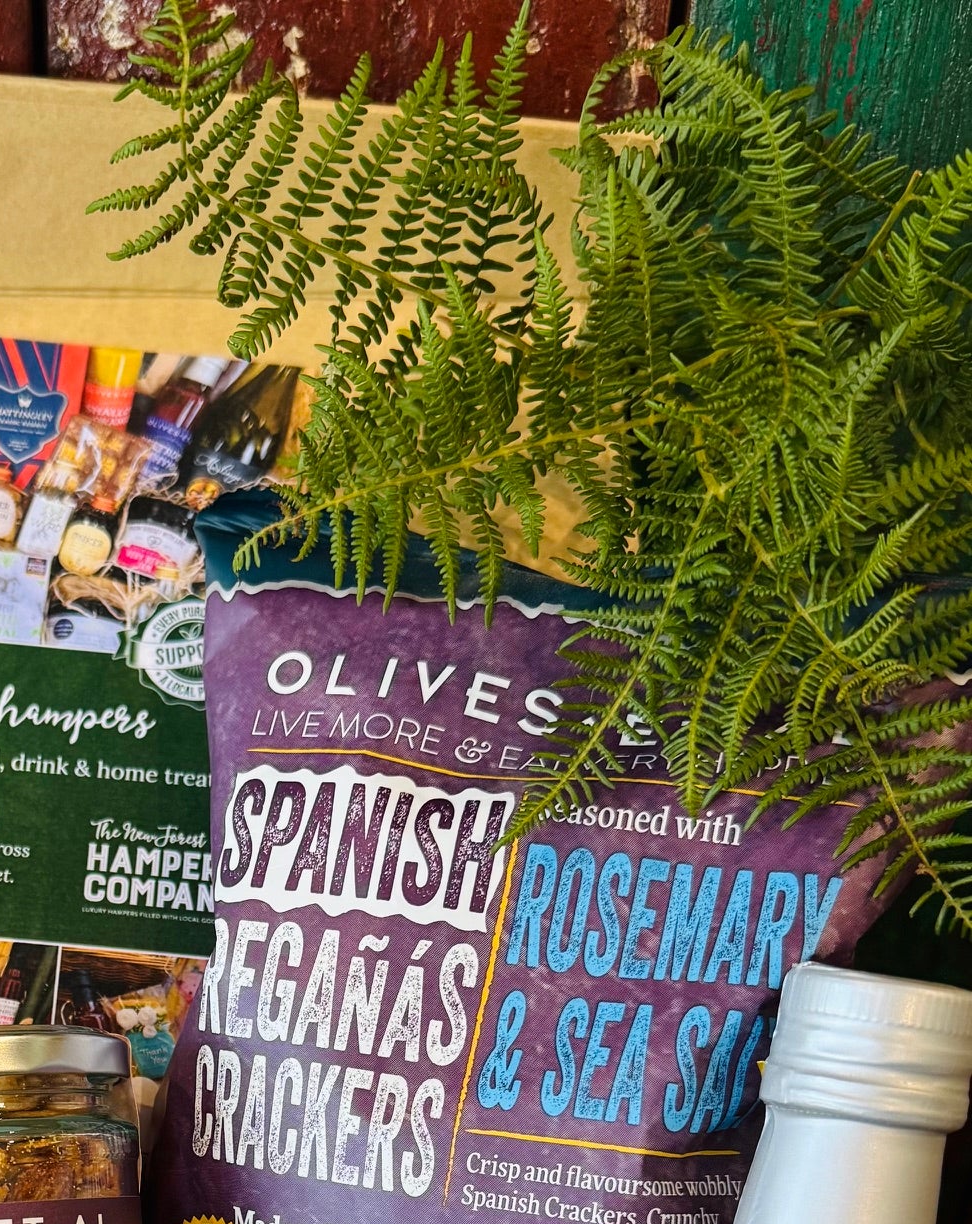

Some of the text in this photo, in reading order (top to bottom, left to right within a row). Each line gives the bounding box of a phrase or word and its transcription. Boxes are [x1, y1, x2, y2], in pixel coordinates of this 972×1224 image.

[251, 710, 446, 755] LIVE MORE
[10, 752, 69, 776] drink
[96, 759, 159, 784] home
[90, 818, 207, 848] The New Forest
[219, 778, 506, 913] SPANISH
[538, 798, 742, 846] easoned with
[108, 909, 138, 917] HAMPERS
[506, 843, 843, 990] ROSEMARY
[198, 918, 479, 1066] REGAÑÁS
[478, 990, 775, 1134] & SEA SAL
[192, 1045, 445, 1197] CRACKERS
[461, 1185, 540, 1214] Spanish
[466, 1152, 742, 1200] Crisp and flavoursome wobbly
